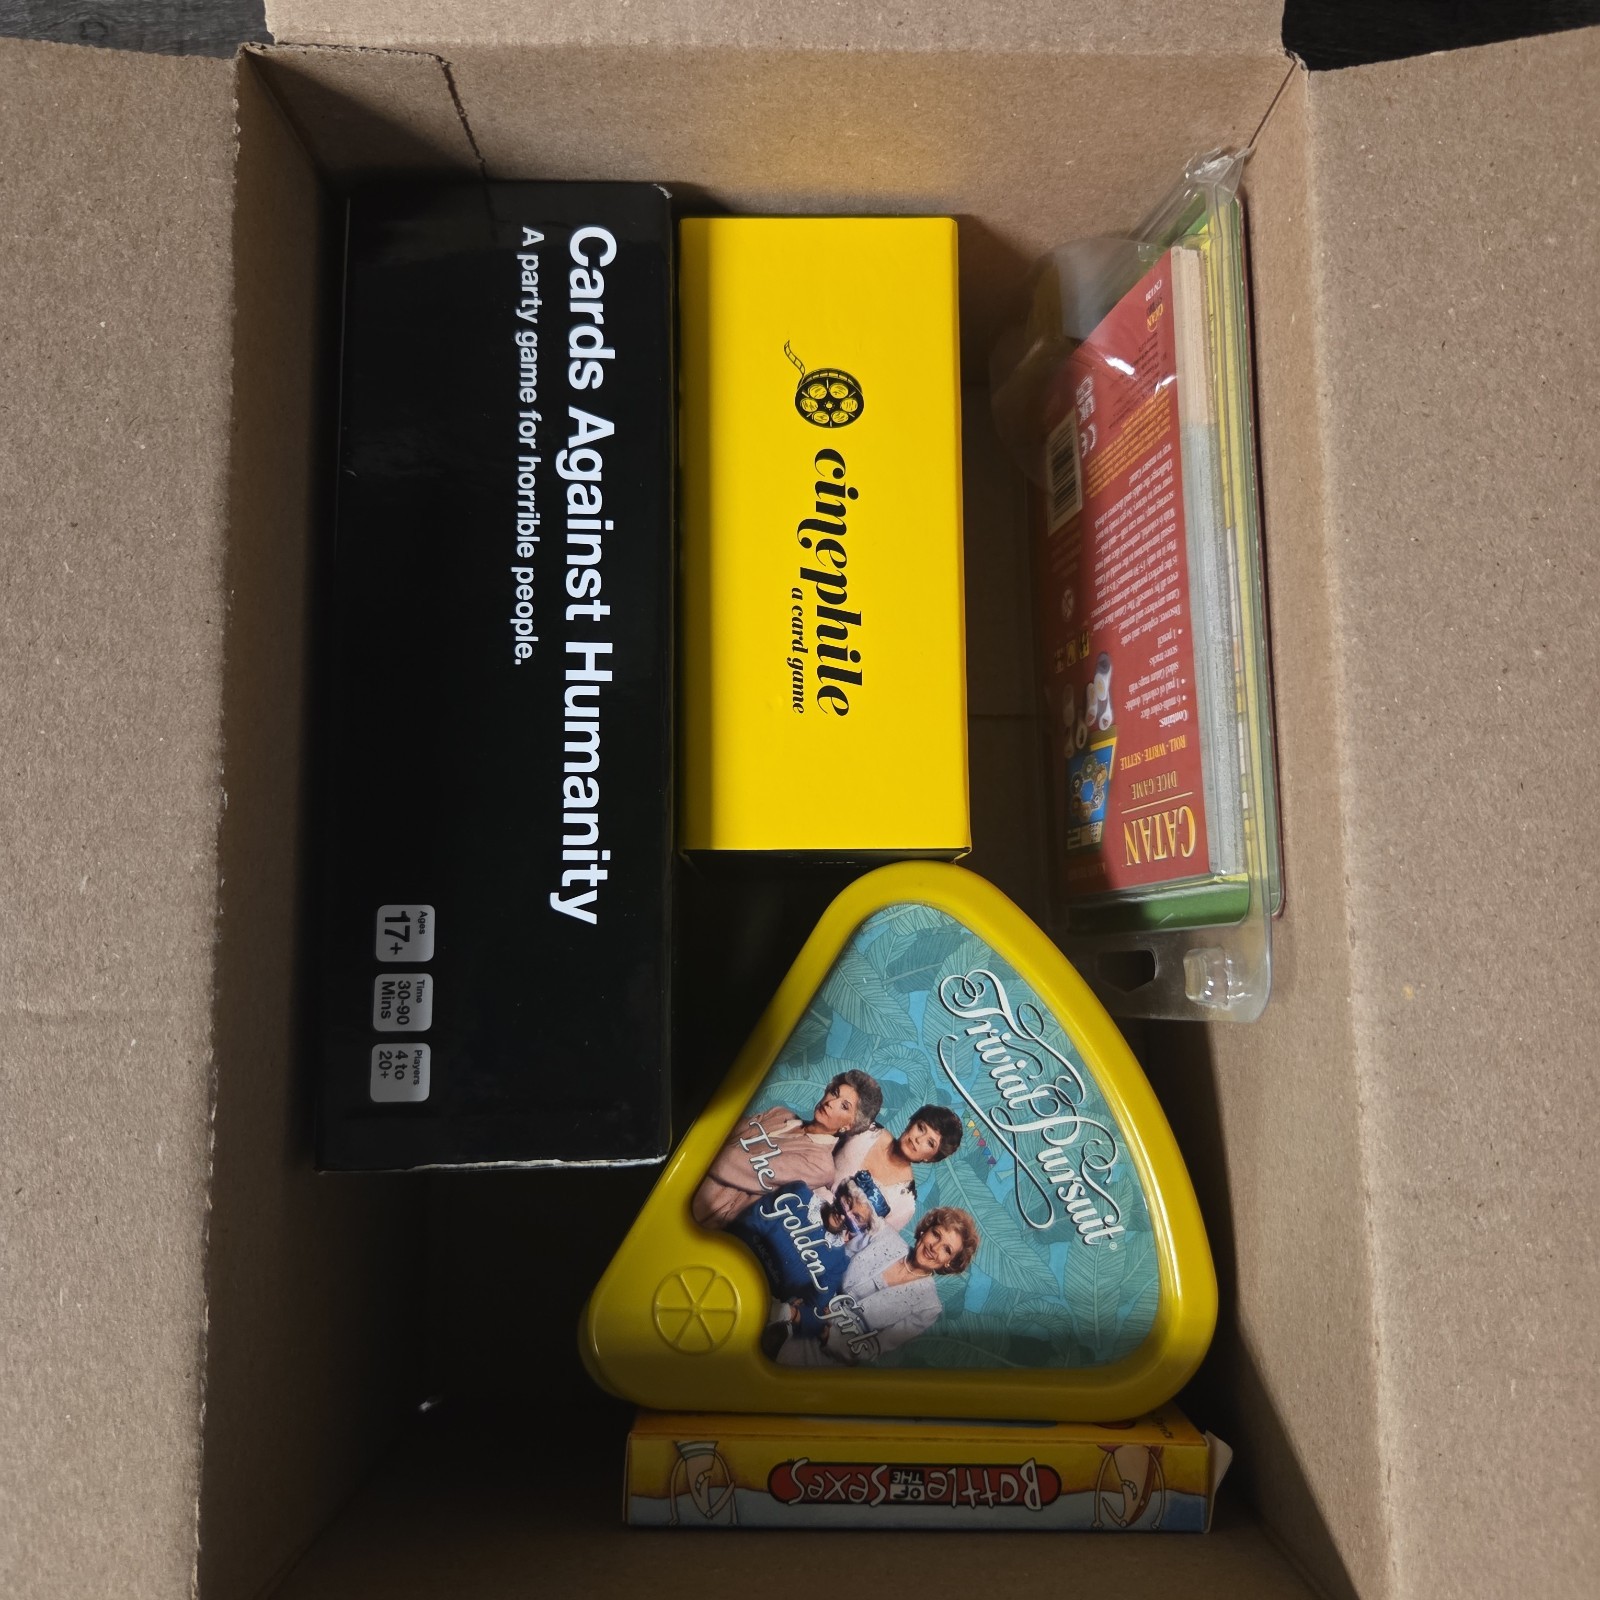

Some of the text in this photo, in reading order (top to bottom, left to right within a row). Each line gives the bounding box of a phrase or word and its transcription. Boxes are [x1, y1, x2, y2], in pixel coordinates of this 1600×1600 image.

[510, 226, 545, 665] A party game for horrible people.
[550, 226, 617, 925] Cards Against Humanity
[796, 448, 863, 717] cinephile
[786, 587, 808, 714] a card game
[1120, 735, 1186, 770] ROLL WRITE SETTLE
[1131, 770, 1178, 800] DICE GAME
[1124, 807, 1196, 865] CATAN
[384, 911, 411, 955] 17+
[417, 911, 428, 935] Ages
[380, 981, 395, 1020] Mins
[396, 980, 411, 1025] 30-90
[416, 979, 425, 1004] Time
[938, 968, 1075, 1110] Trivial
[378, 1050, 393, 1079] 20+
[394, 1050, 409, 1080] 4 to
[412, 1049, 423, 1086] Players
[740, 1121, 781, 1190] The
[760, 1192, 831, 1291] Golden
[814, 1294, 880, 1358] Girls
[787, 1457, 1043, 1510] Battle OF THE Sexes
